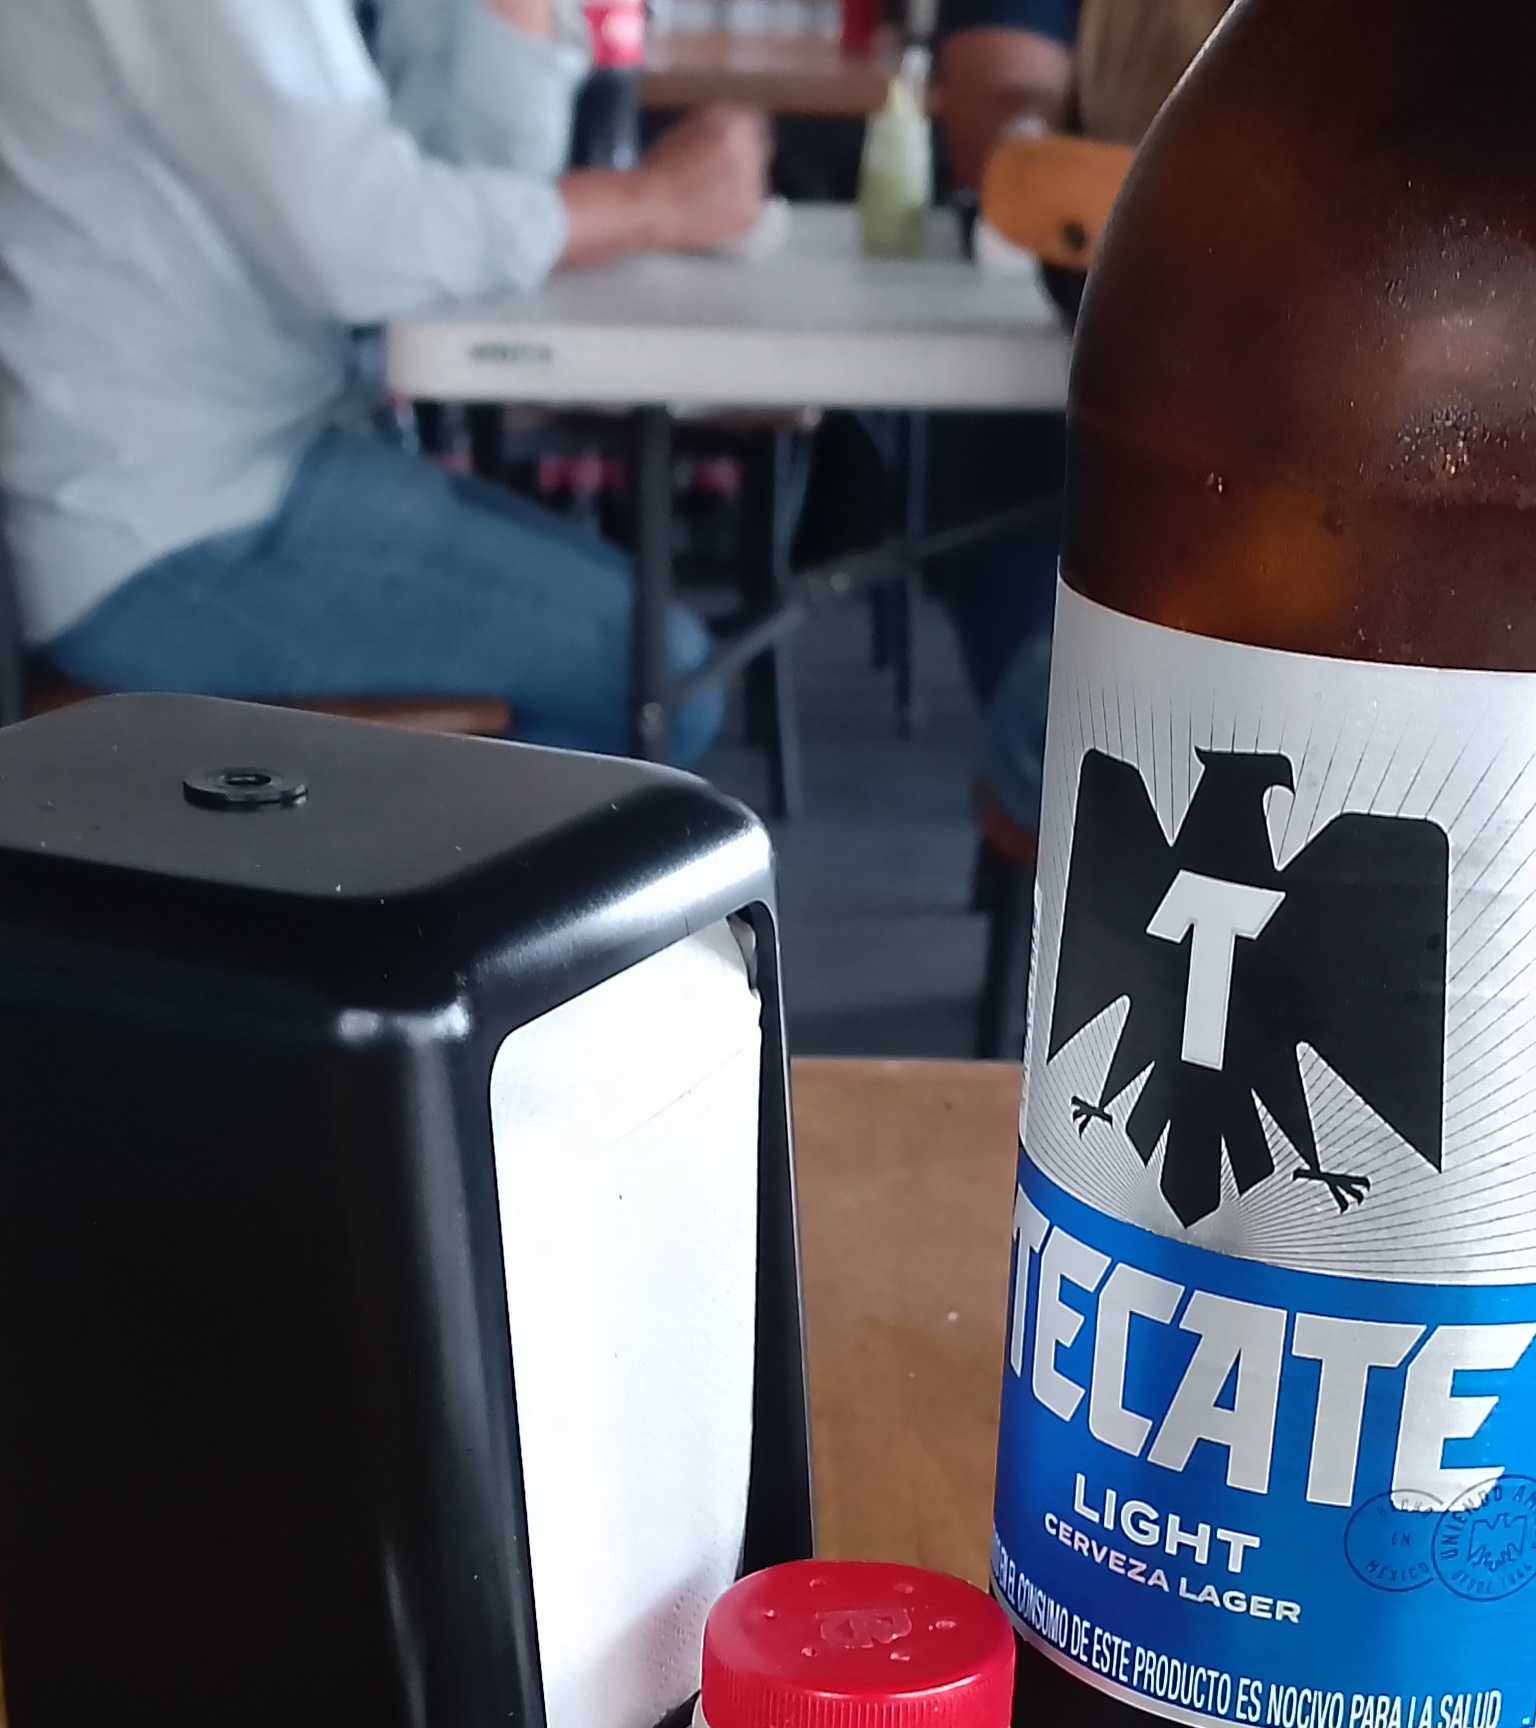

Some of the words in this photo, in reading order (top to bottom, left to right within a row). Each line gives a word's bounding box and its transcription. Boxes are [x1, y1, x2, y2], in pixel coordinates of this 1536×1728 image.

[1145, 870, 1286, 1071] T
[1044, 1512, 1170, 1592] CERVEZA
[1179, 1577, 1301, 1624] LAGER
[1074, 1473, 1261, 1573] LIGHT
[1391, 1532, 1411, 1546] EN
[1017, 1572, 1069, 1648] CONSUMO
[1070, 1613, 1091, 1662] DE
[1091, 1626, 1131, 1683] ESTE
[1133, 1646, 1232, 1715] PRODUCTO
[1236, 1677, 1263, 1723] ES
